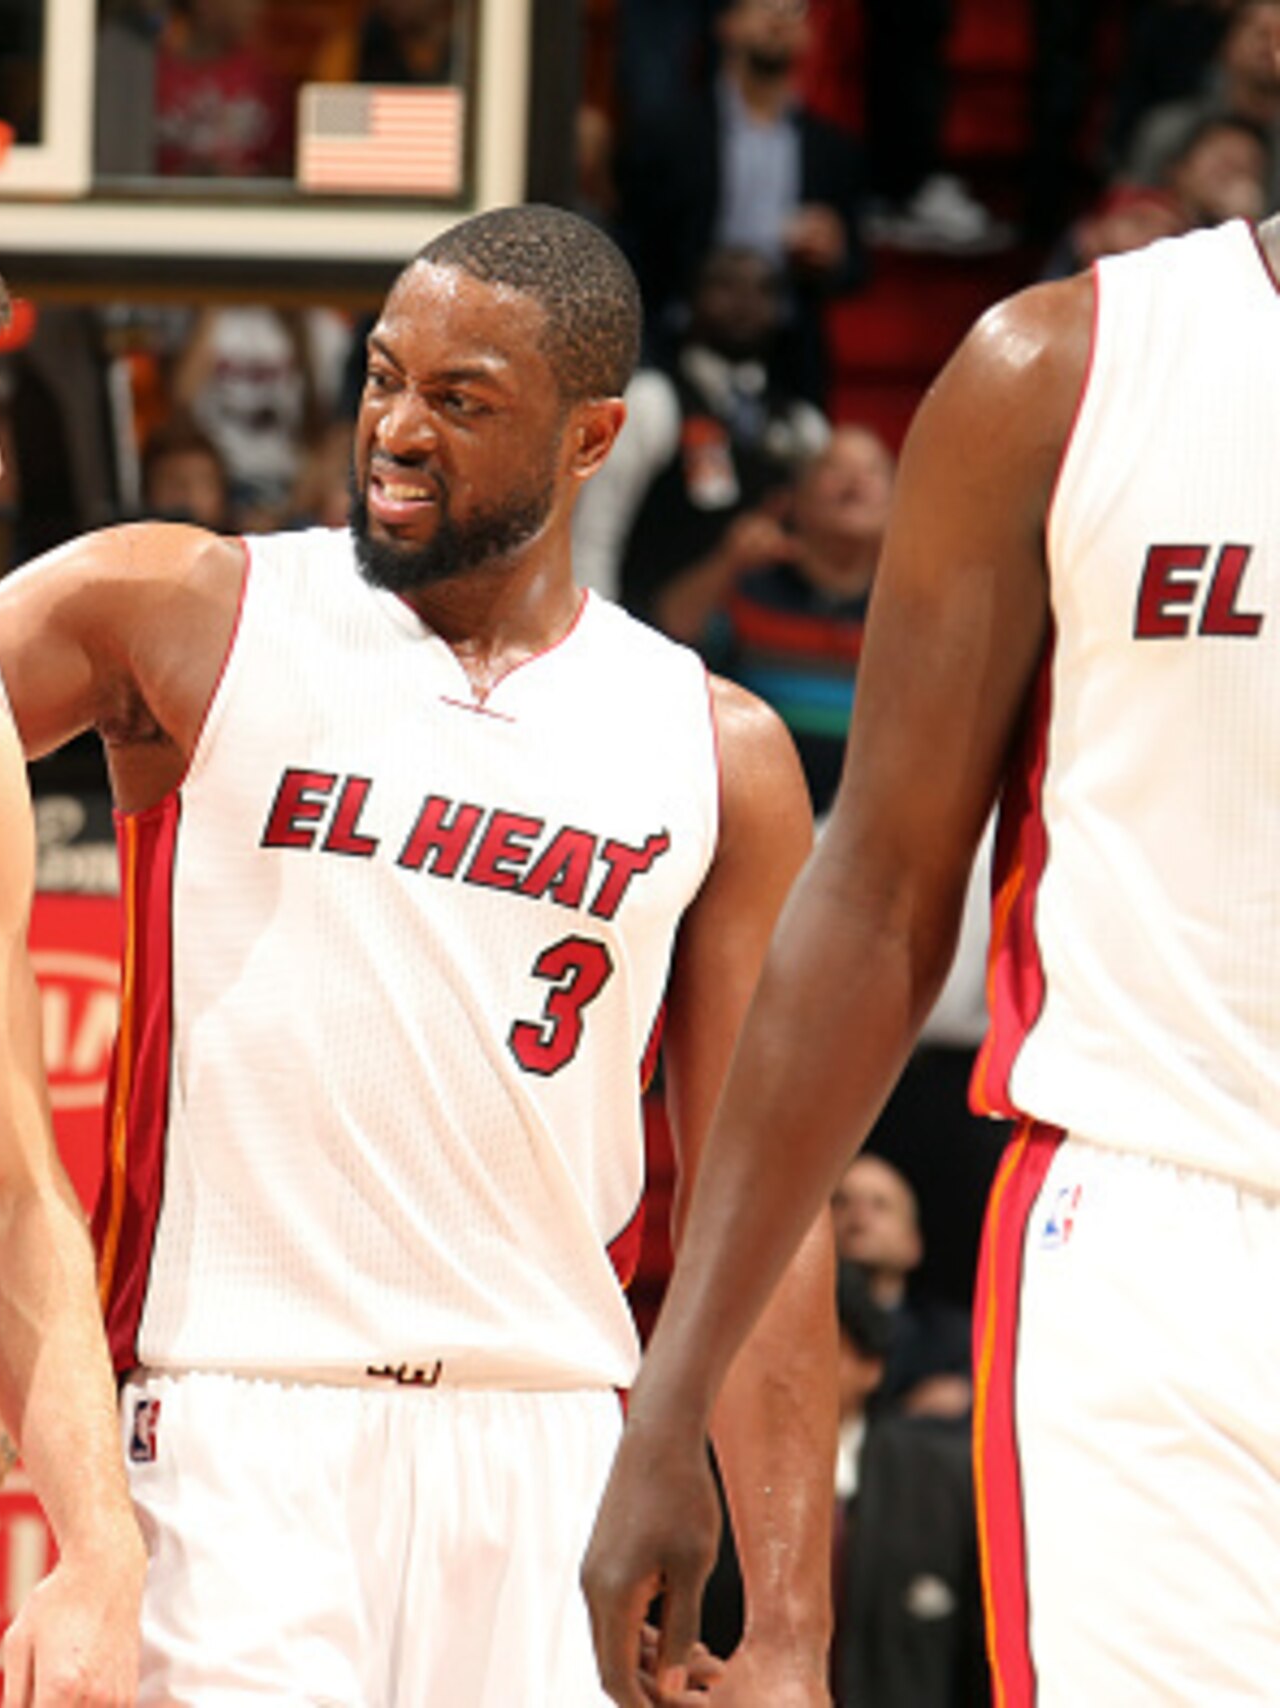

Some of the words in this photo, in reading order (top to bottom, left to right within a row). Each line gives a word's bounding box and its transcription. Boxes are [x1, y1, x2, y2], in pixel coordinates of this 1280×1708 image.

[1134, 544, 1263, 640] EL
[260, 767, 379, 858] EL
[396, 795, 671, 921] HEAT
[507, 934, 615, 1077] 3
